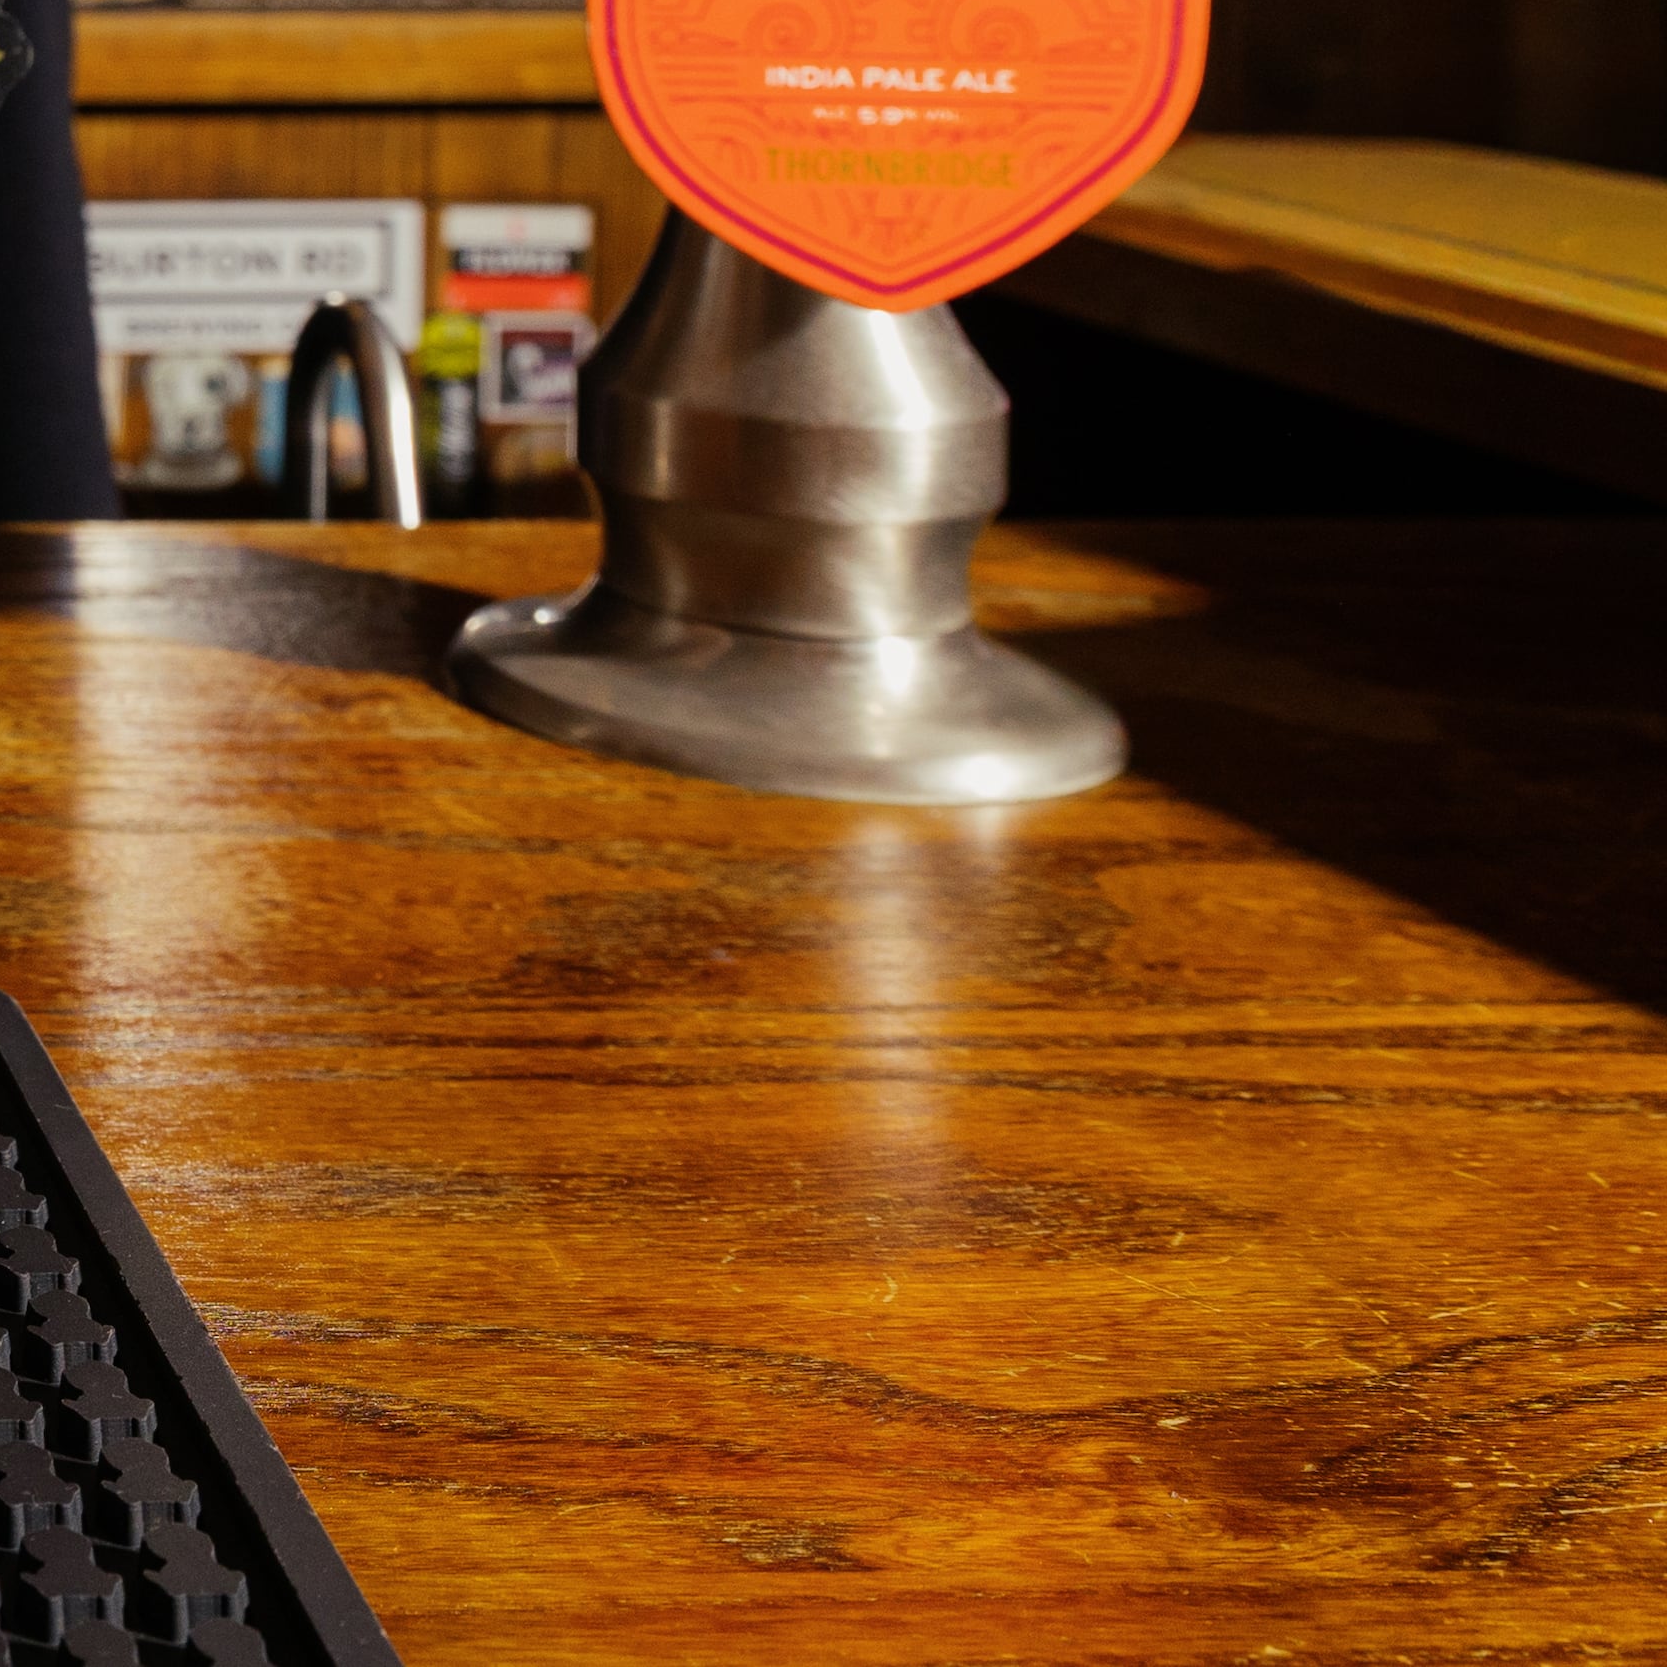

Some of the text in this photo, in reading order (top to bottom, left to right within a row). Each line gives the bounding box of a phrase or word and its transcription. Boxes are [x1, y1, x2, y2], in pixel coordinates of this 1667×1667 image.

[765, 66, 1016, 94] INDIA PALE ALE
